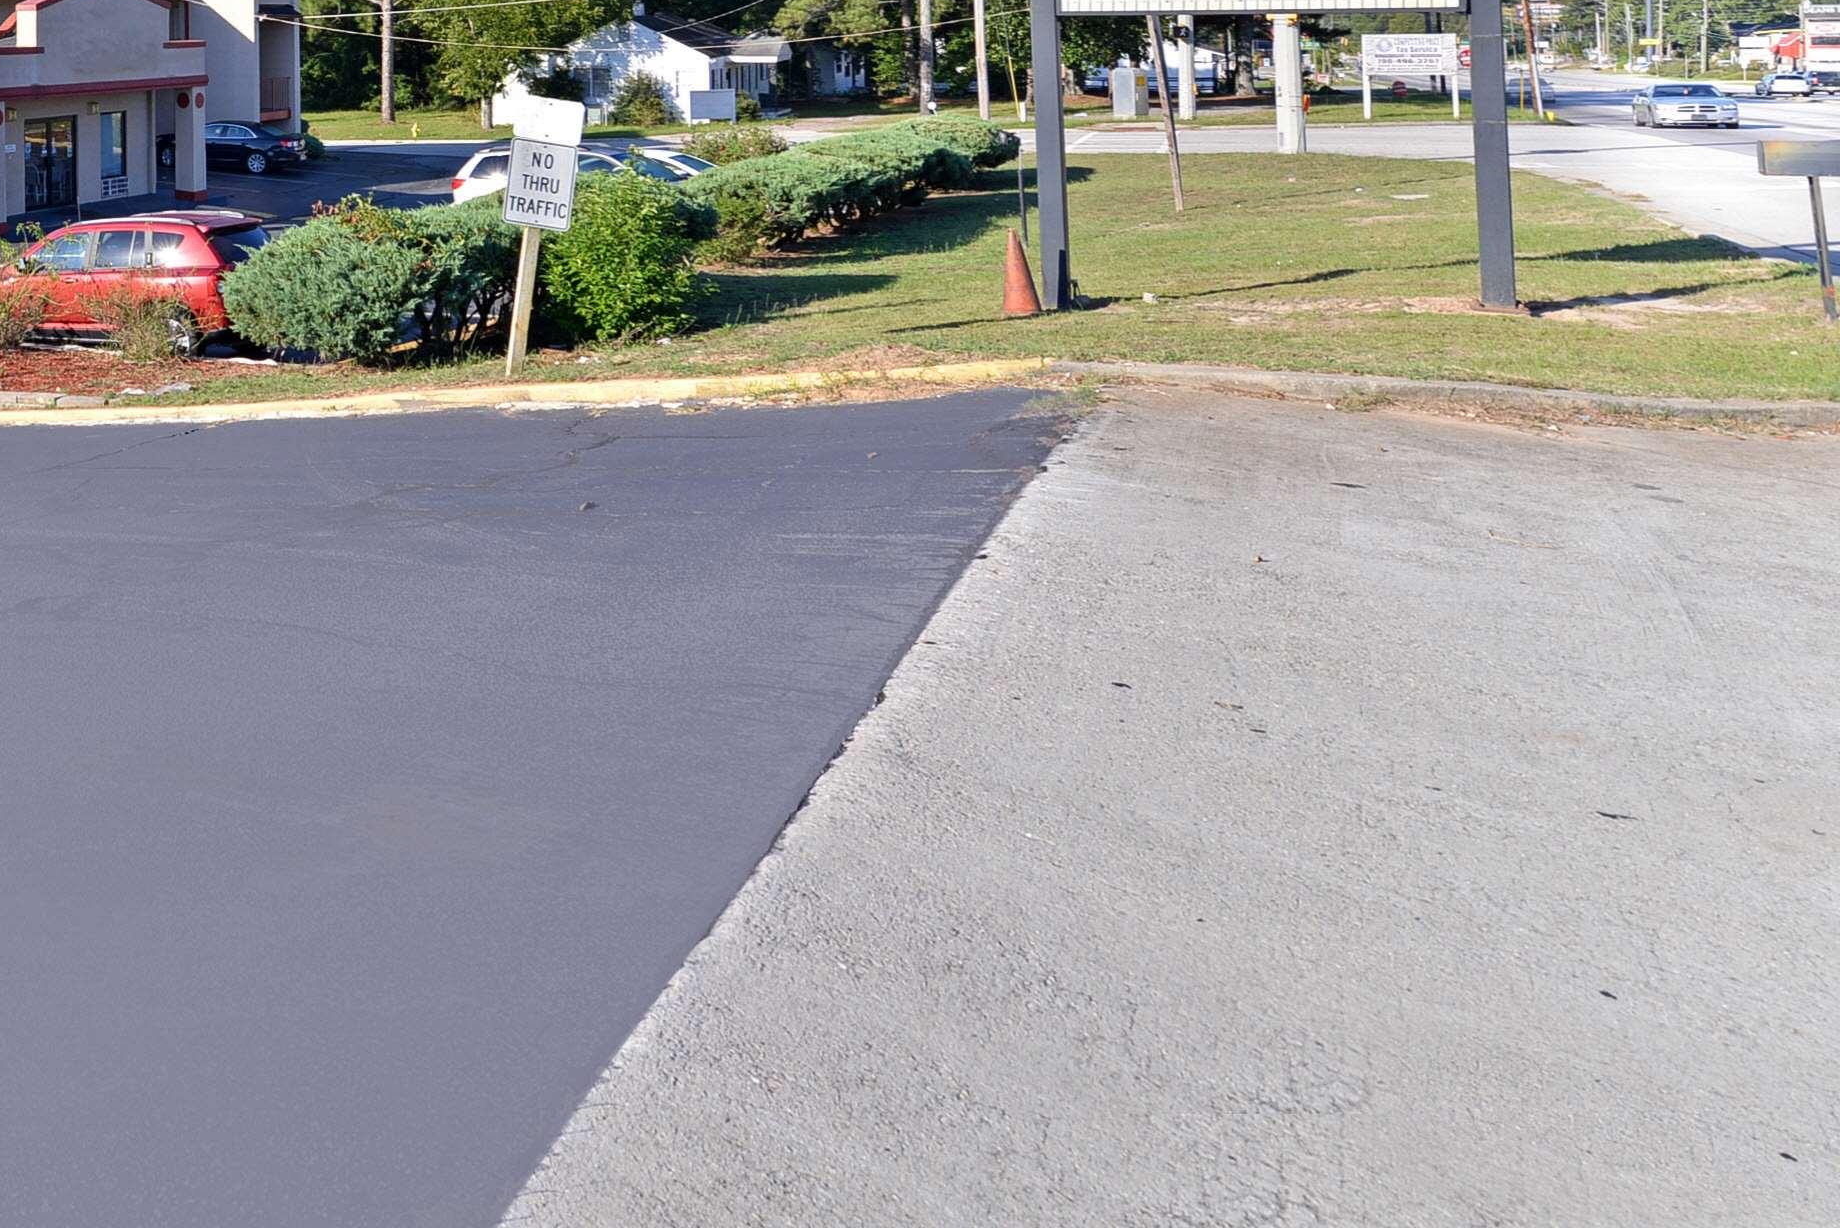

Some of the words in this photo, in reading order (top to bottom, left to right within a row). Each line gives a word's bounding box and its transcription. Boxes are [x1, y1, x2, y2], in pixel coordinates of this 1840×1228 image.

[531, 152, 554, 169] NO
[522, 173, 560, 194] THRU
[510, 195, 567, 219] TRAFFIC
